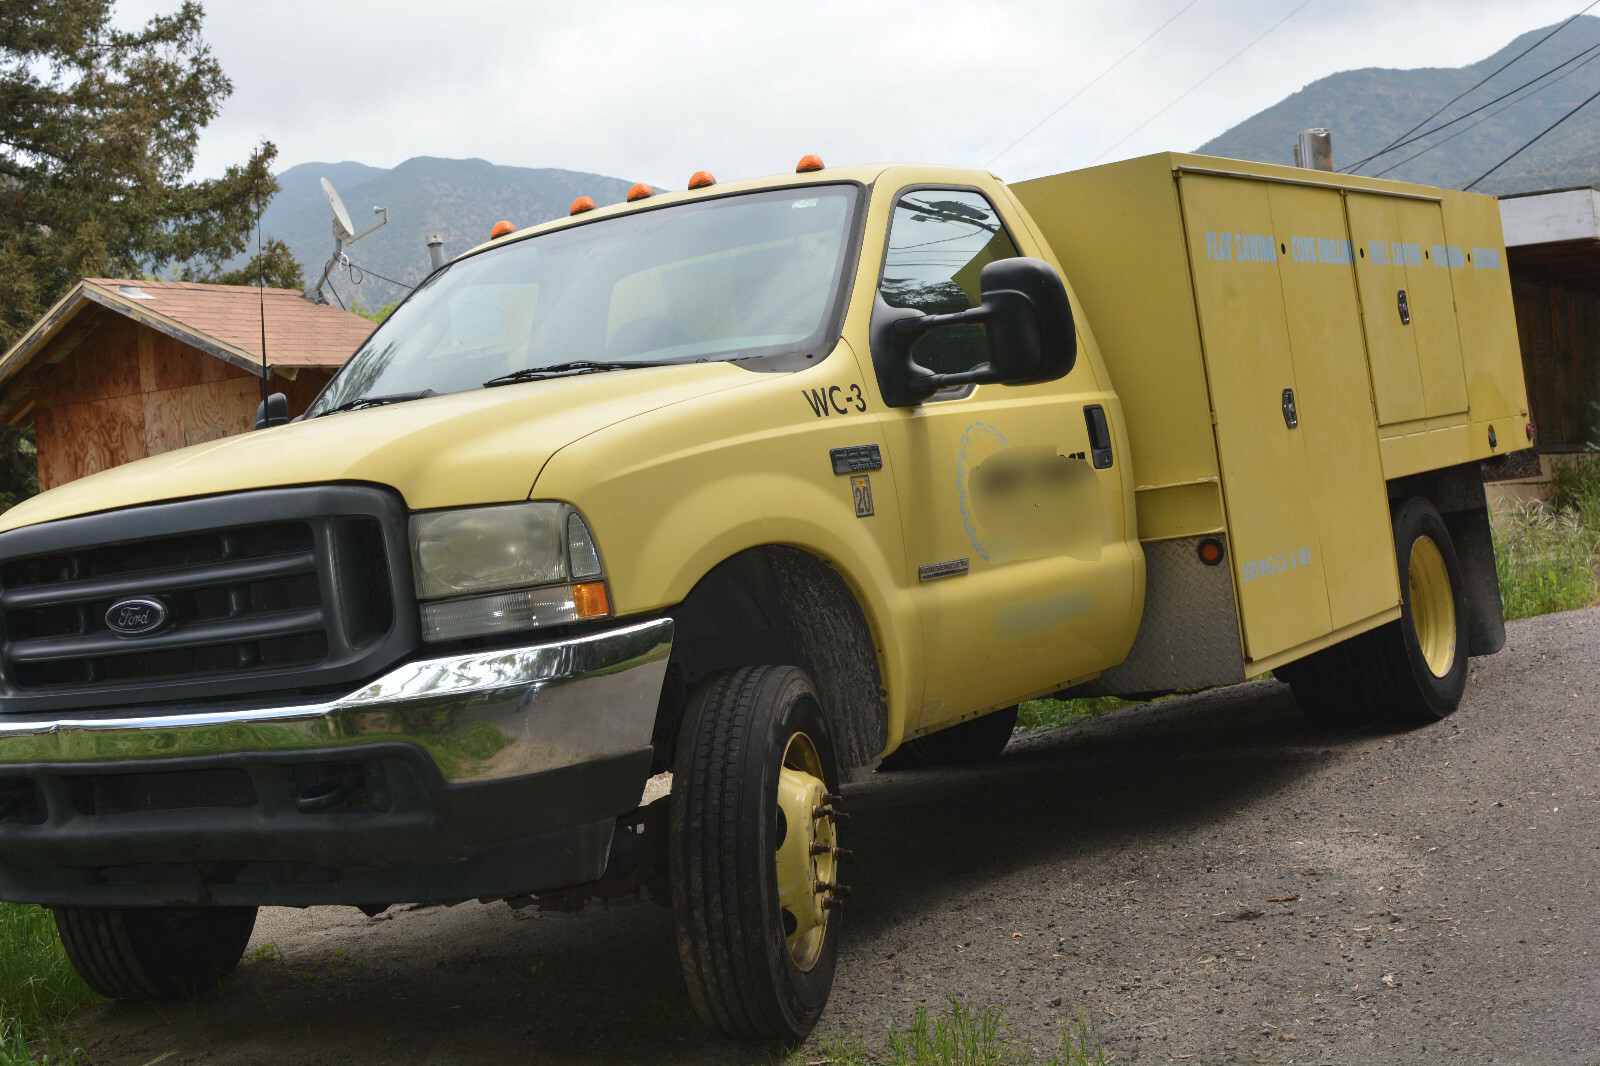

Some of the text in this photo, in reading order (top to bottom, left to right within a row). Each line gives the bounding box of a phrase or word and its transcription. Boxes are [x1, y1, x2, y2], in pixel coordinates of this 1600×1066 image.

[1206, 231, 1277, 263] FLAT SAWING
[1291, 235, 1316, 263] CORE
[1368, 240, 1422, 267] WALL SAWING
[801, 384, 867, 417] WC-3
[855, 486, 872, 513] 20
[1241, 556, 1275, 582] SERVING
[1291, 550, 1297, 569] &
[118, 606, 150, 627] Ford
